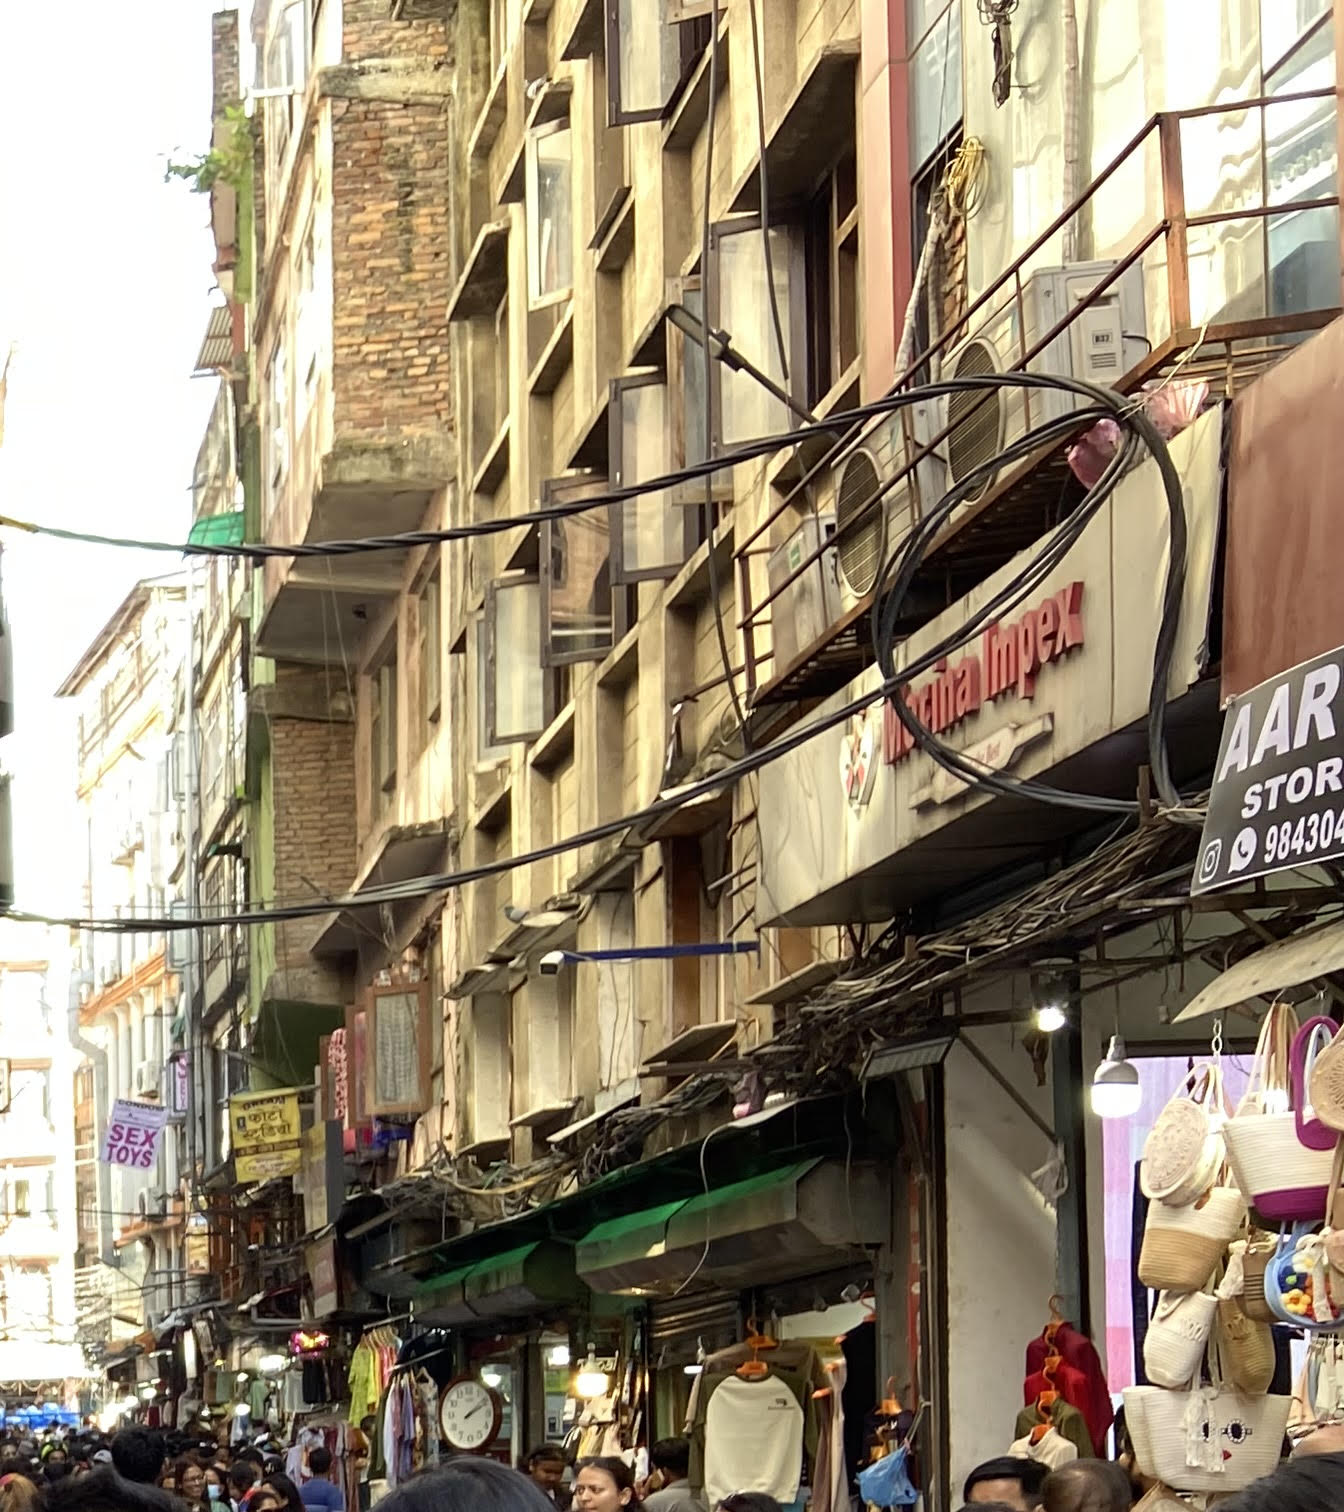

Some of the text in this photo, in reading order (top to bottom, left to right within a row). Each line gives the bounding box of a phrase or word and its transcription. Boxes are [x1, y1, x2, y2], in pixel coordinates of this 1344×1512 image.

[983, 581, 1085, 700] Impex
[1217, 663, 1341, 783] AAR
[106, 1143, 153, 1168] TOYS
[110, 1124, 158, 1149] SEX
